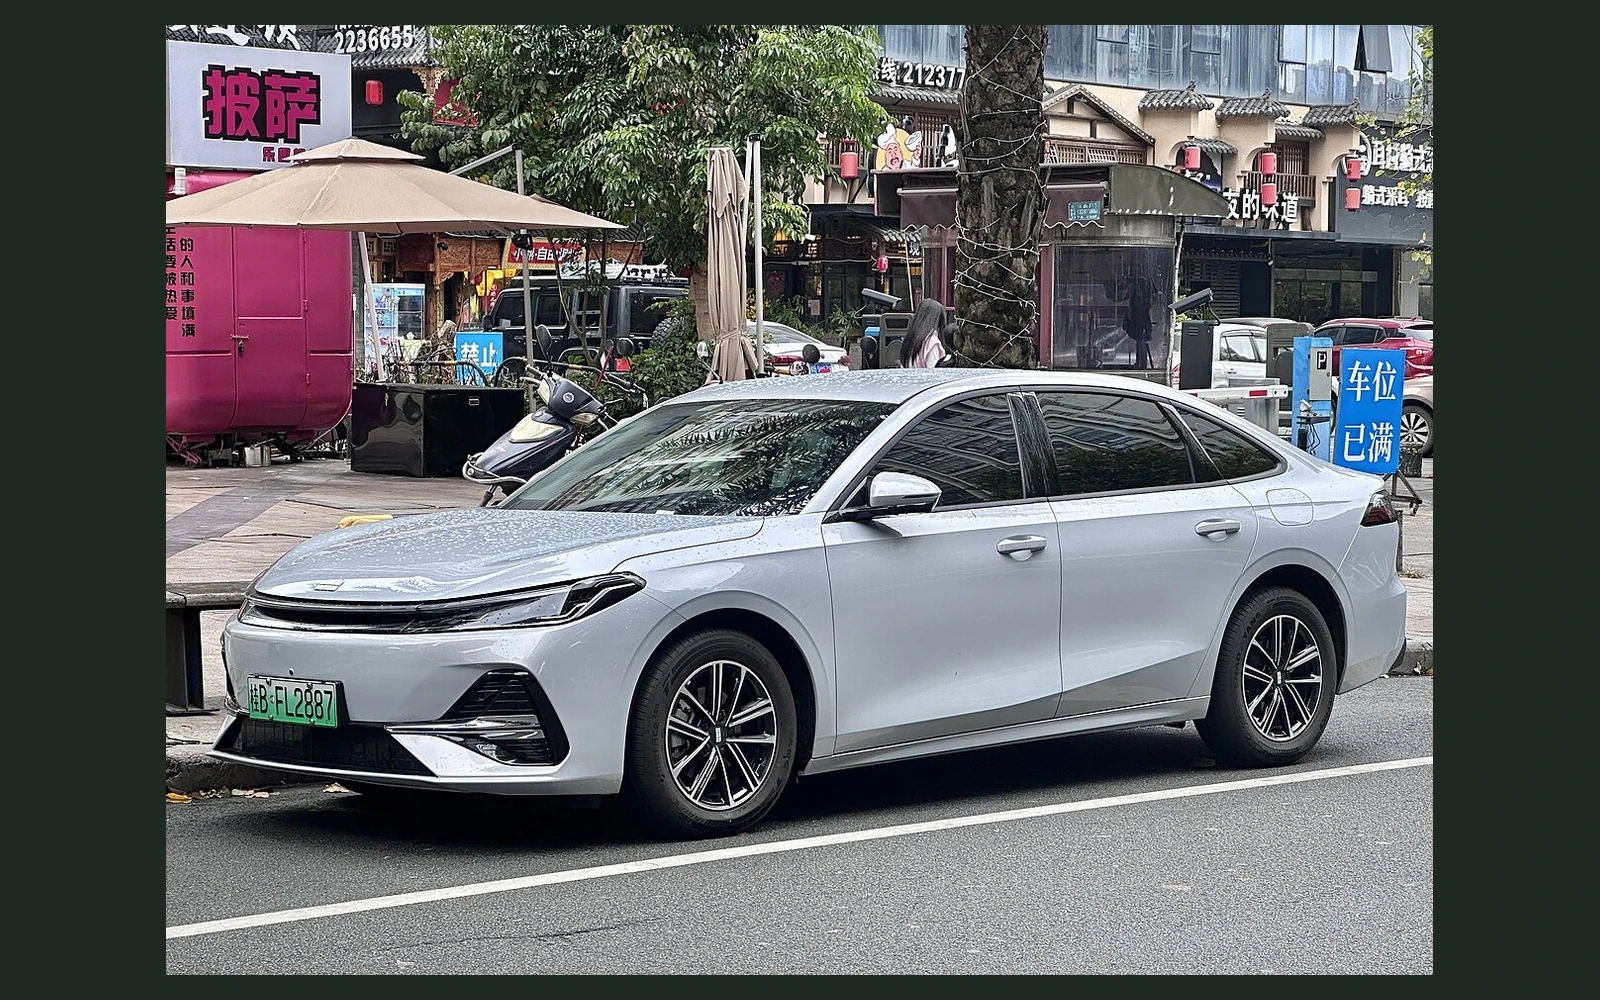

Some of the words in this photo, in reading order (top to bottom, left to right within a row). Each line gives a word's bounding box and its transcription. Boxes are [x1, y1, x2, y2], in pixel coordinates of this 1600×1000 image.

[335, 25, 413, 54] 2236655
[203, 64, 320, 143] 披萨
[180, 237, 196, 337] 的人和事填满
[461, 342, 498, 368] 禁止
[1317, 352, 1327, 369] P
[1346, 360, 1398, 402] 车位
[1343, 422, 1394, 463] 已满
